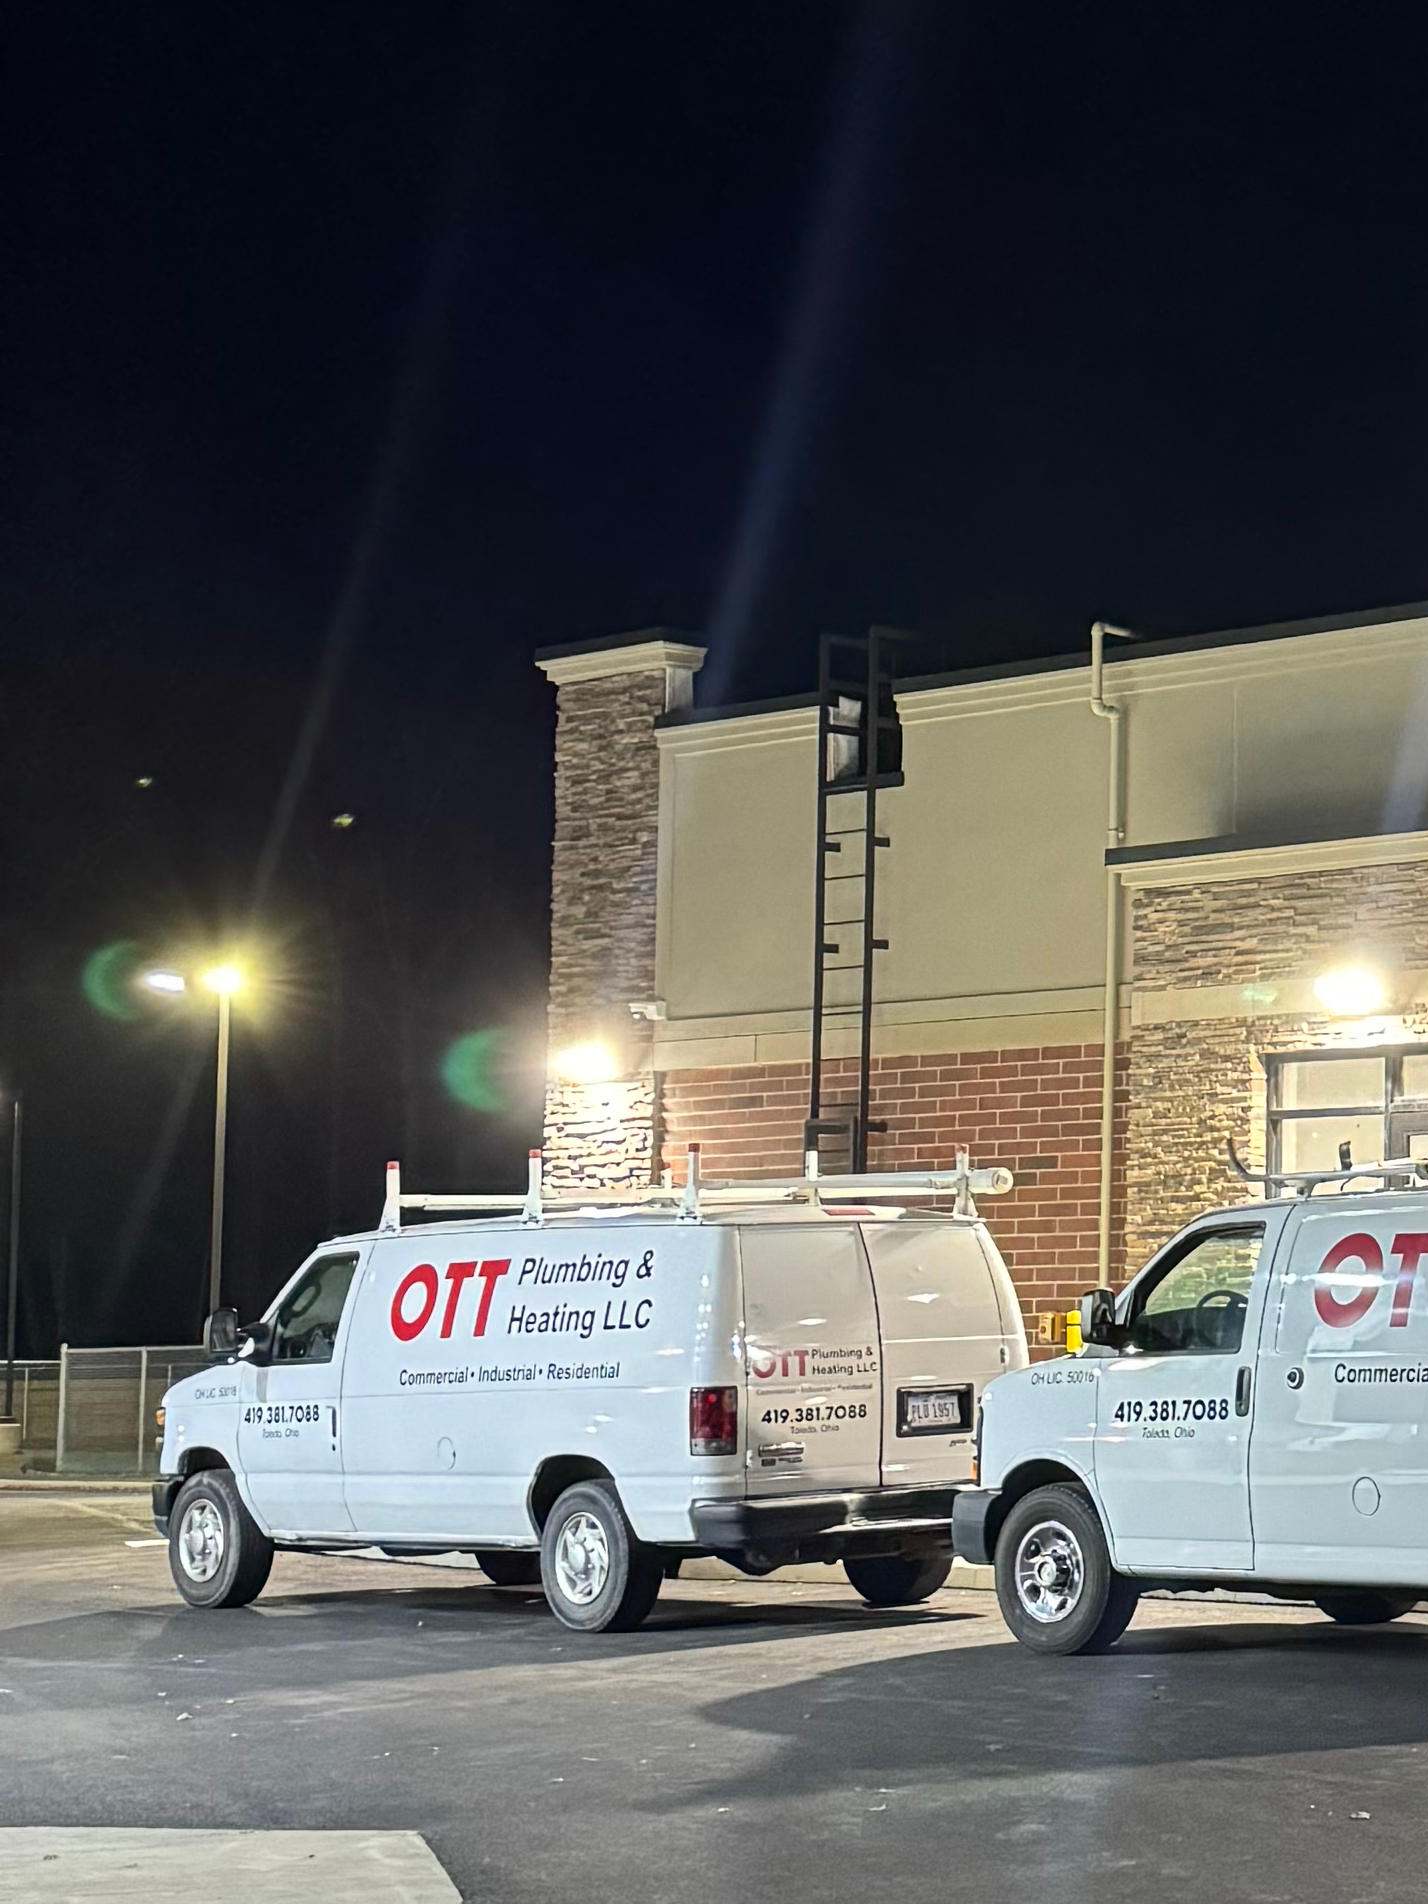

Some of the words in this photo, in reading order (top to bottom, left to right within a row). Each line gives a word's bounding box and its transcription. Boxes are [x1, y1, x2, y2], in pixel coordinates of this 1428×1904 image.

[518, 1253, 630, 1288] Plumbing
[637, 1250, 654, 1279] &
[391, 1259, 511, 1341] OTT
[507, 1303, 595, 1339] Heating
[603, 1299, 652, 1330] LLC
[811, 1348, 863, 1359] Plumbing
[865, 1346, 873, 1356] &
[400, 1369, 468, 1385] Commercial
[478, 1364, 536, 1382] Industrial
[547, 1362, 620, 1380] Residential
[812, 1364, 854, 1376] Heating
[856, 1362, 878, 1373] LLC
[1031, 1372, 1045, 1385] OH
[244, 1404, 320, 1423] 419.381.7088
[761, 1404, 867, 1423] 419.381.7088
[1114, 1399, 1229, 1422] 419.381.7088
